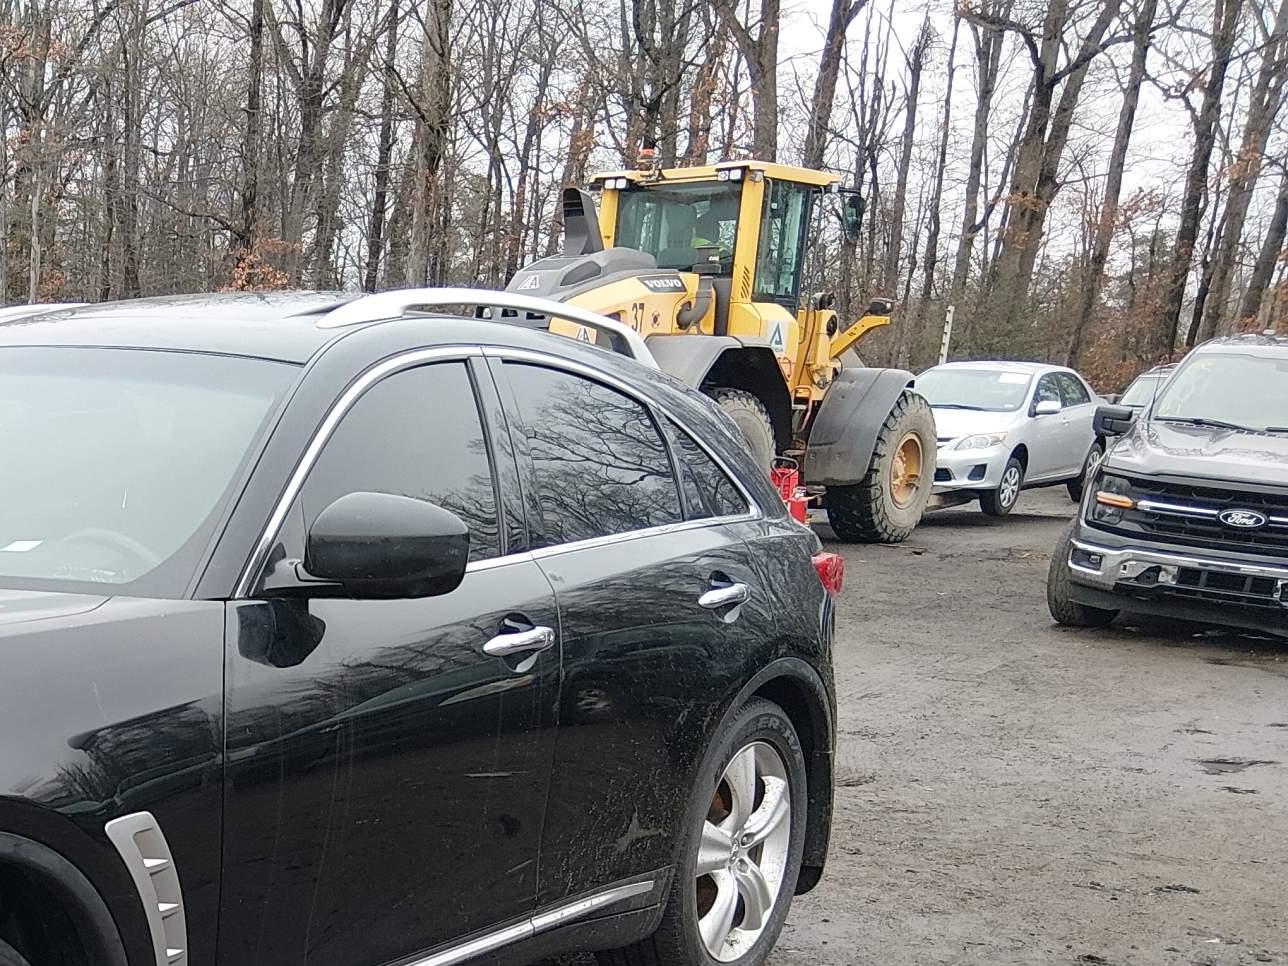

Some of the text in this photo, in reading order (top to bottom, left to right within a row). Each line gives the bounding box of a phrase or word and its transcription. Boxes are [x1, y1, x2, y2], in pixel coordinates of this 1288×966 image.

[644, 279, 682, 289] VOLVO
[631, 302, 645, 332] 37
[1227, 512, 1257, 525] Ford
